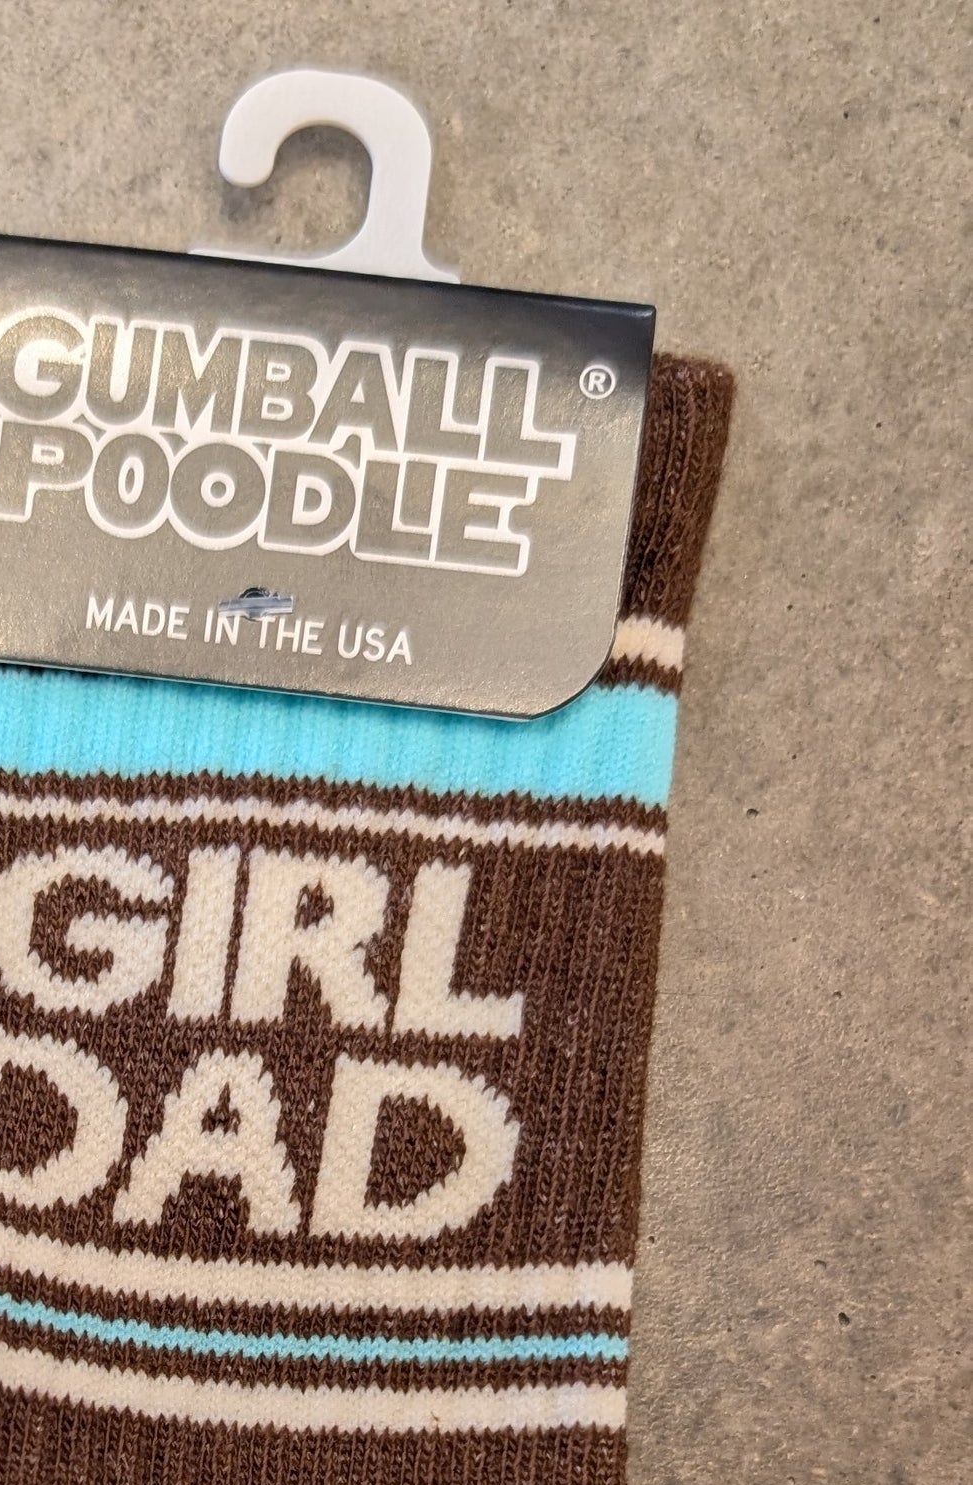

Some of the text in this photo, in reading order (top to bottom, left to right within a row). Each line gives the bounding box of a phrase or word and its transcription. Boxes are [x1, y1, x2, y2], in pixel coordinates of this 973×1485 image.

[85, 596, 413, 666] MADE IN THE USA
